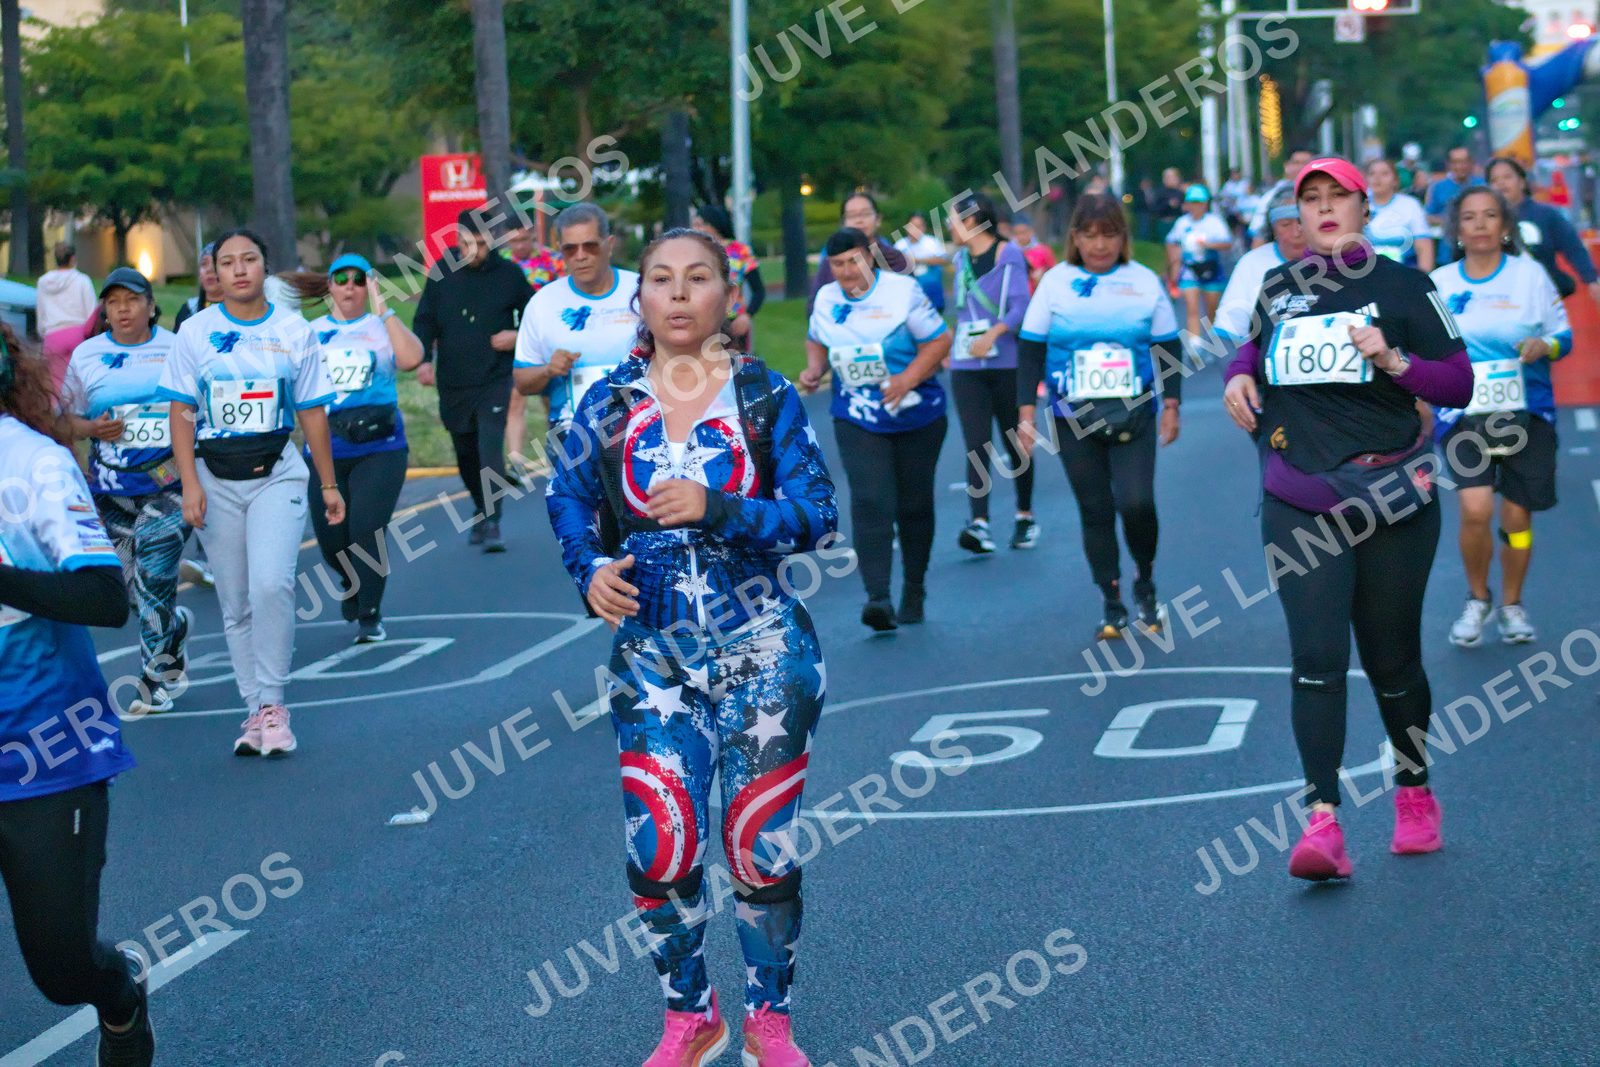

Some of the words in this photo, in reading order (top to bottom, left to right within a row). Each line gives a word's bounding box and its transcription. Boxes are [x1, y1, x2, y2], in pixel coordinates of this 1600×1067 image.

[1283, 342, 1358, 375] 1802
[332, 365, 370, 385] 275
[1078, 369, 1131, 391] 1004
[222, 401, 264, 425] 891
[123, 421, 164, 442] 565
